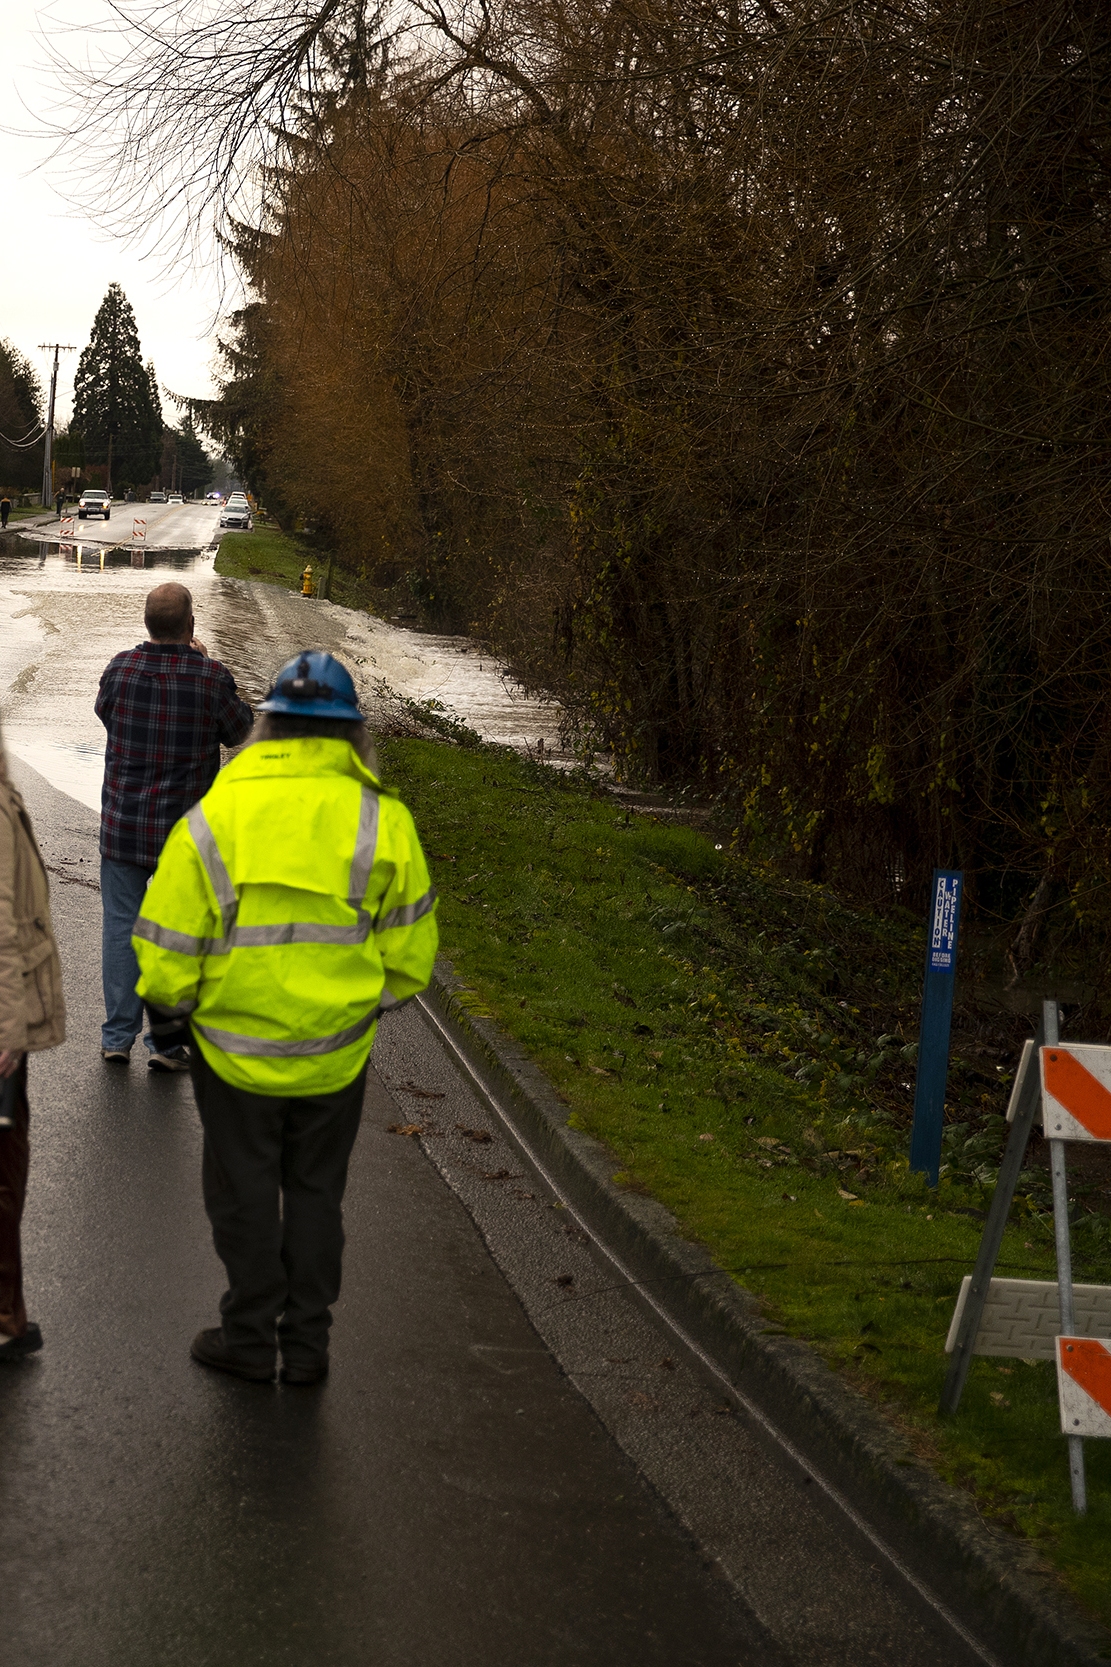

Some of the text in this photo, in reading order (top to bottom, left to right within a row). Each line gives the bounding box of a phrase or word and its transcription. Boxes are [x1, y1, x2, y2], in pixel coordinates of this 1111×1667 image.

[933, 880, 944, 946] CAUTION
[942, 891, 952, 937] WATER
[947, 879, 958, 949] PIPELINE
